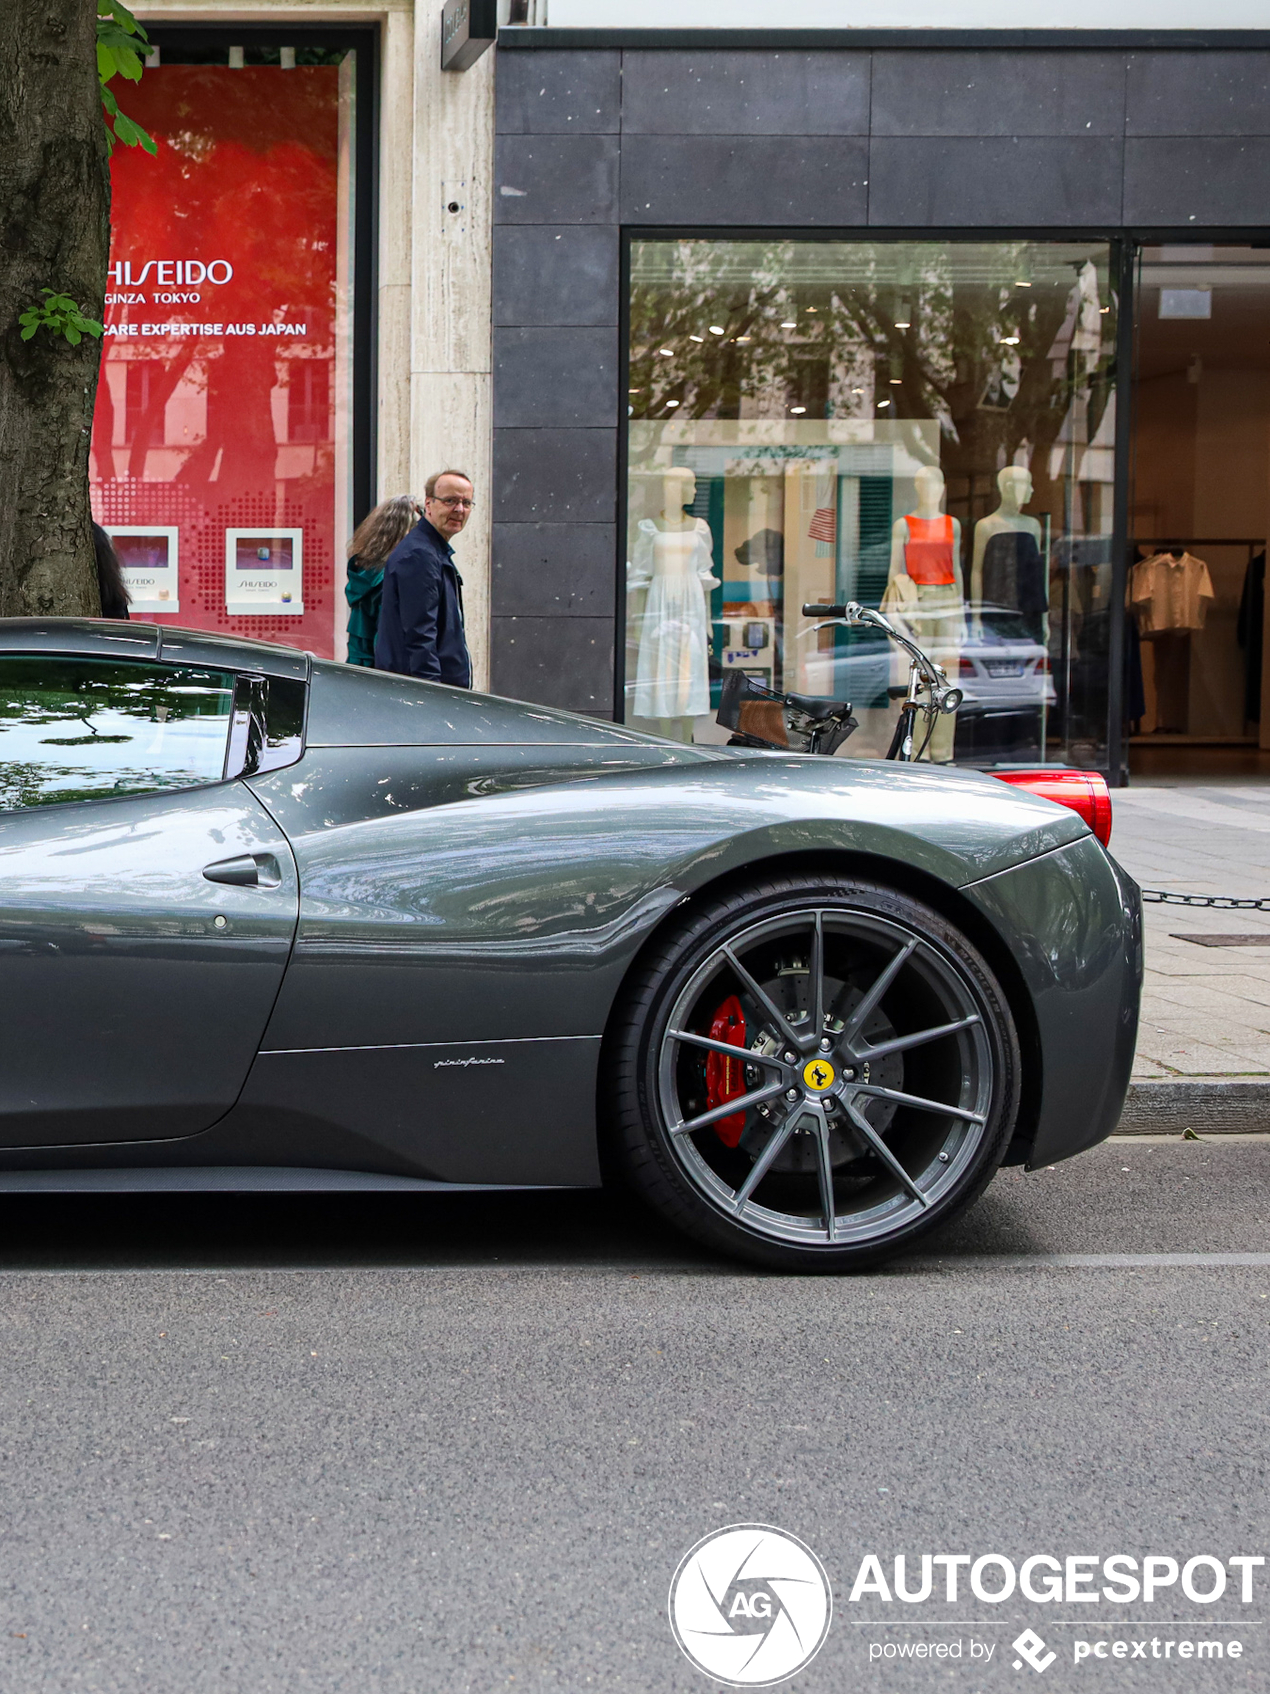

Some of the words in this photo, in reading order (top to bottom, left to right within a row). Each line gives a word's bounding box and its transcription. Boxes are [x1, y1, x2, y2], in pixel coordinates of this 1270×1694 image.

[107, 259, 234, 286] HISEIDO
[103, 292, 146, 305] GINZA
[153, 292, 202, 304] TOKYO
[141, 323, 224, 336] EXPERTISE
[225, 323, 257, 336] AUS
[257, 323, 307, 336] JAPAN
[124, 578, 156, 586] HISEIDO
[237, 580, 278, 589] SHISEIDO
[959, 947, 1001, 1014] MICHELIN
[433, 1056, 505, 1069] pininfarina
